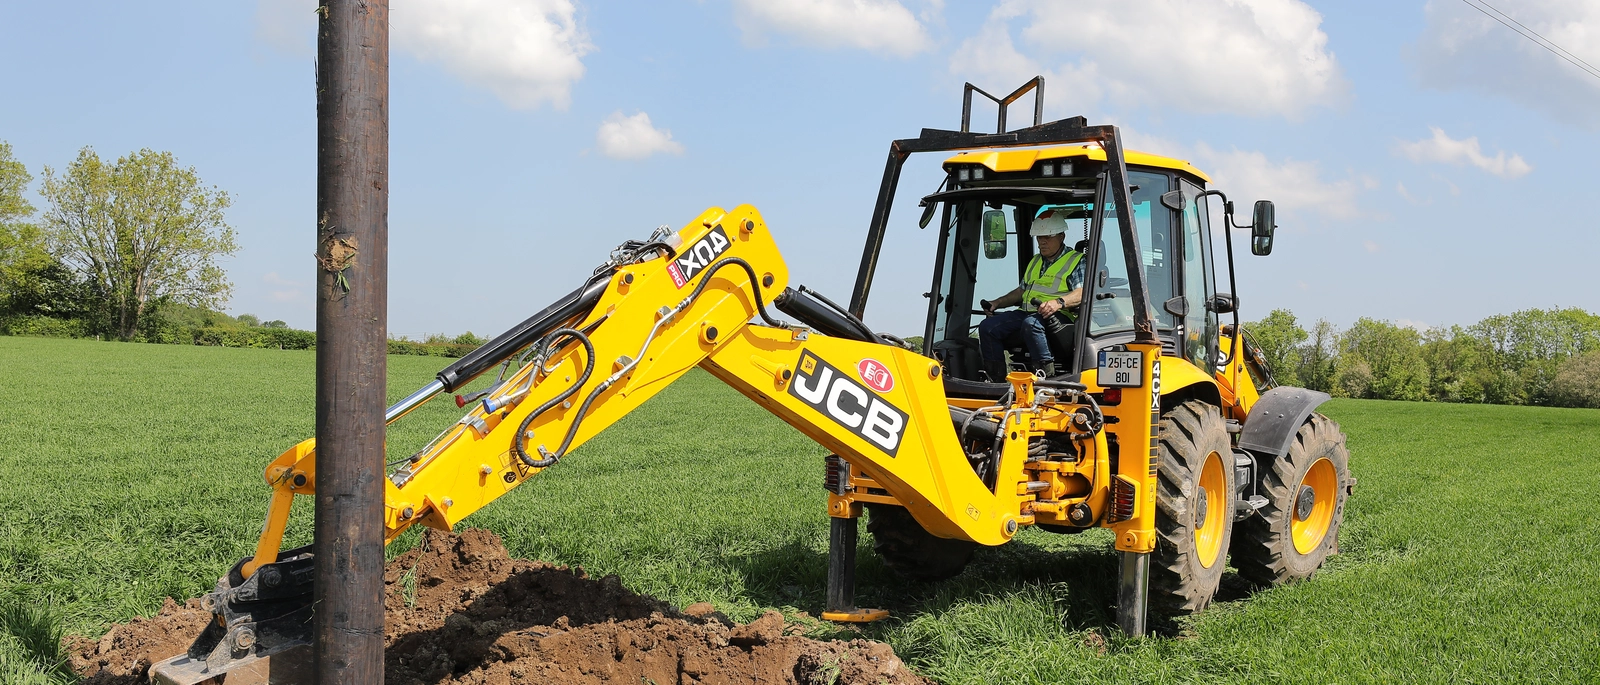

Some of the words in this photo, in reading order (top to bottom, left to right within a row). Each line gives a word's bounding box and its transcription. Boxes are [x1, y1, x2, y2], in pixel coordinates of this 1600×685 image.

[678, 230, 728, 280] 4CX
[668, 264, 684, 287] PRO
[1108, 357, 1139, 369] 251-CE
[1115, 372, 1130, 383] 801
[1151, 362, 1160, 408] 4CX
[794, 366, 903, 450] JCB
